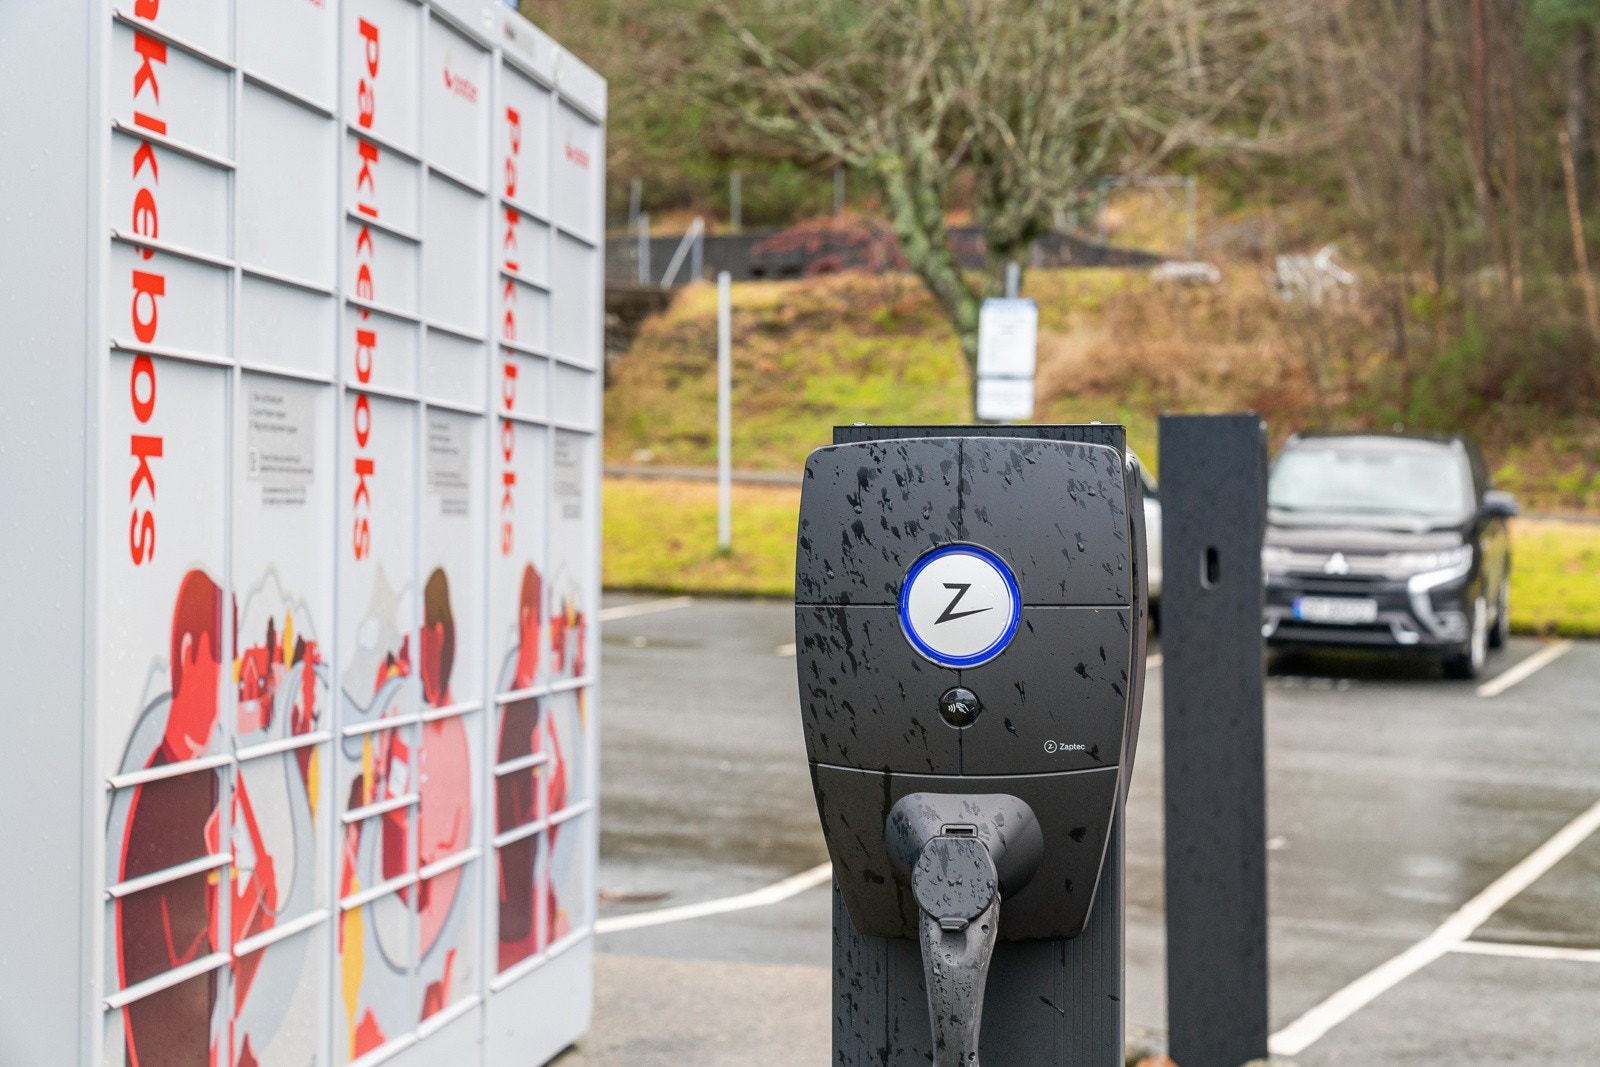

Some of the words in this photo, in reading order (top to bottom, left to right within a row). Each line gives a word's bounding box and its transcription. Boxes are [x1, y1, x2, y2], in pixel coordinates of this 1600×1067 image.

[352, 17, 380, 561] Pakkeboks
[934, 582, 994, 625] Z
[1059, 742, 1086, 752] Zaptec
